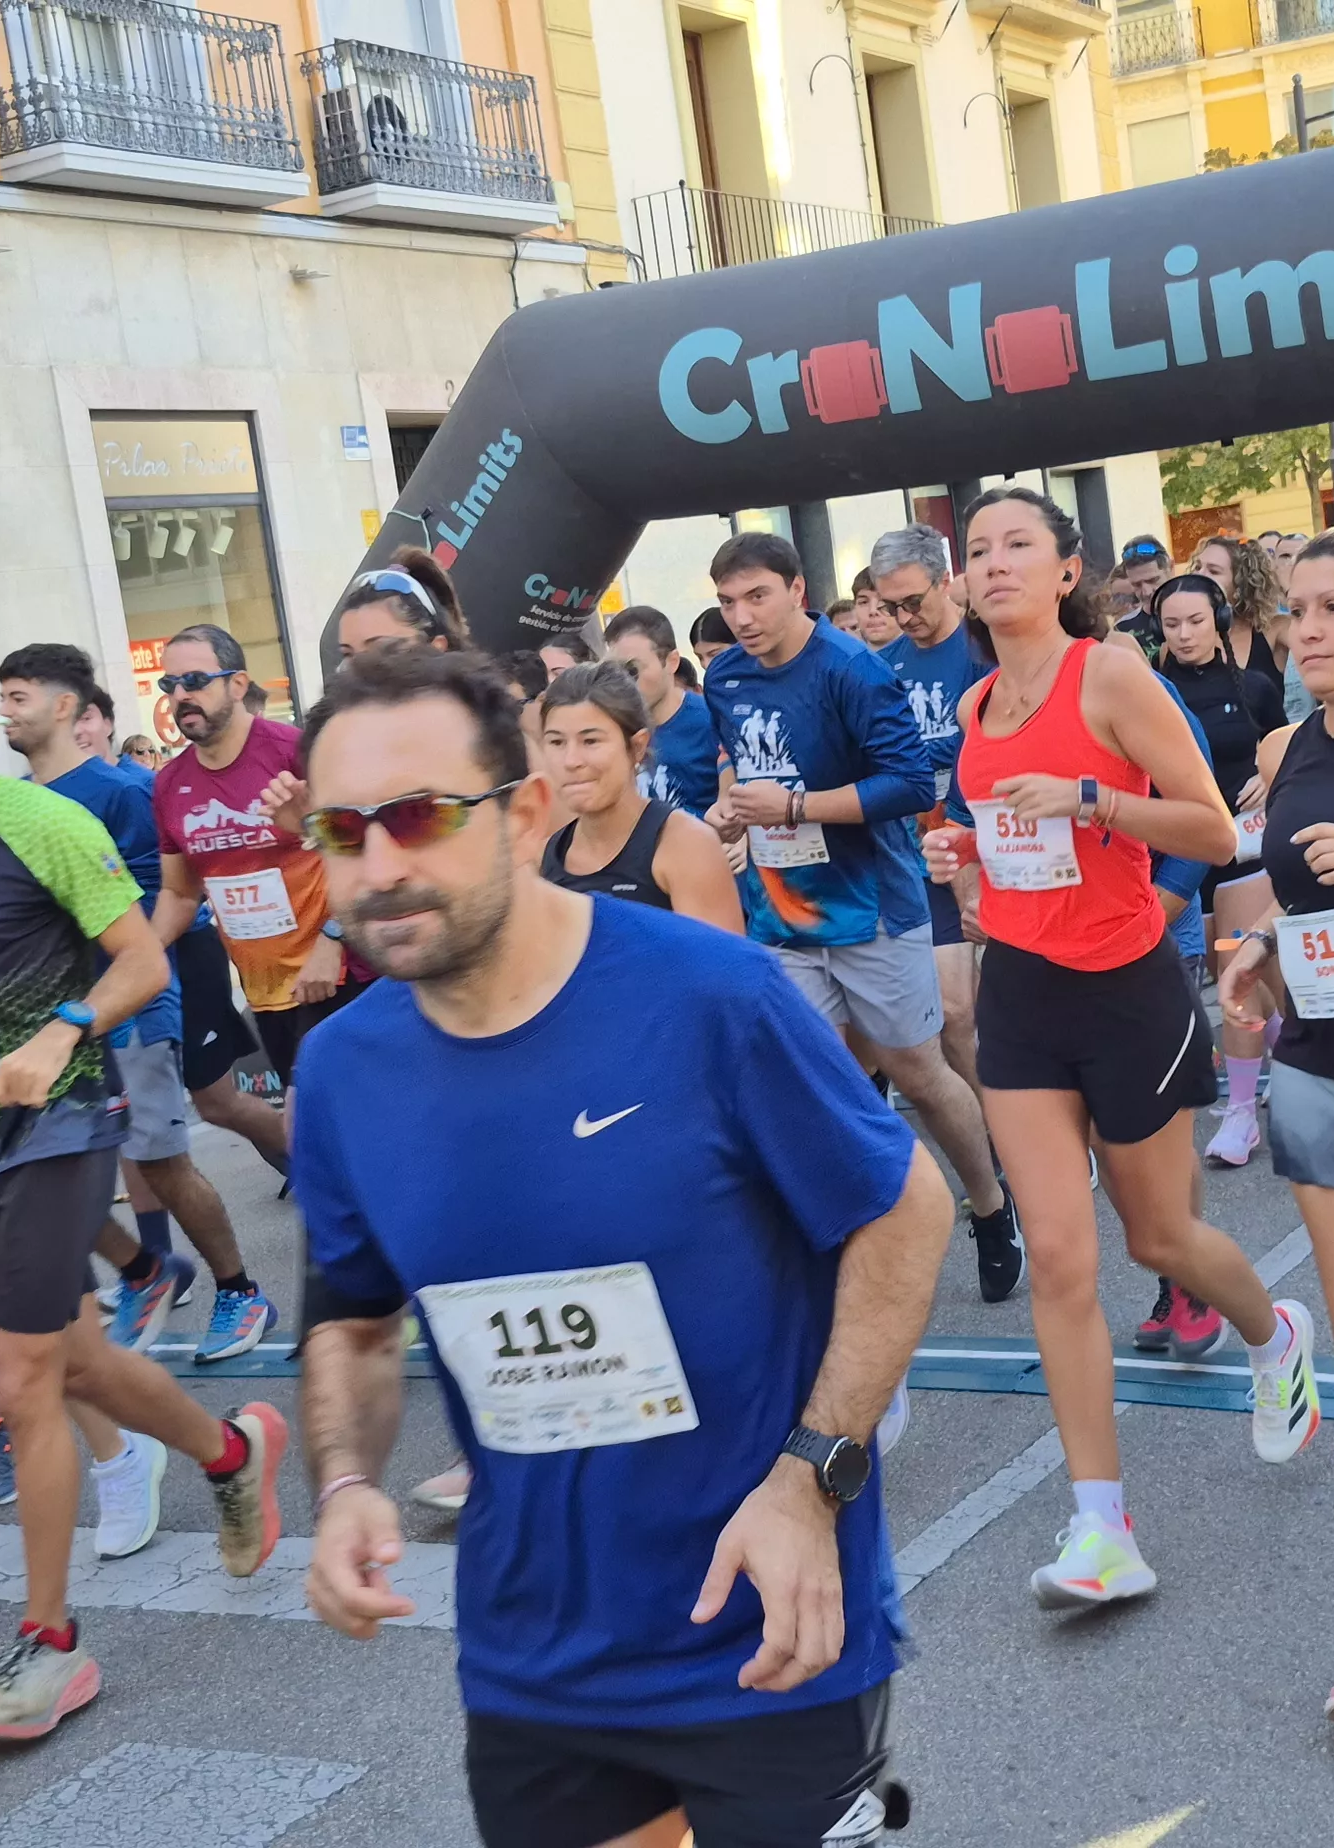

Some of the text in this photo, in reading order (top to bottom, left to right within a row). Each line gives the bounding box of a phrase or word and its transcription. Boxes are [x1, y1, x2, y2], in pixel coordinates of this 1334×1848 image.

[103, 441, 249, 477] Pilar Prieto
[187, 828, 277, 855] HUESCA
[224, 884, 260, 906] 577
[487, 1303, 598, 1359] 119
[486, 1363, 537, 1387] JOSE
